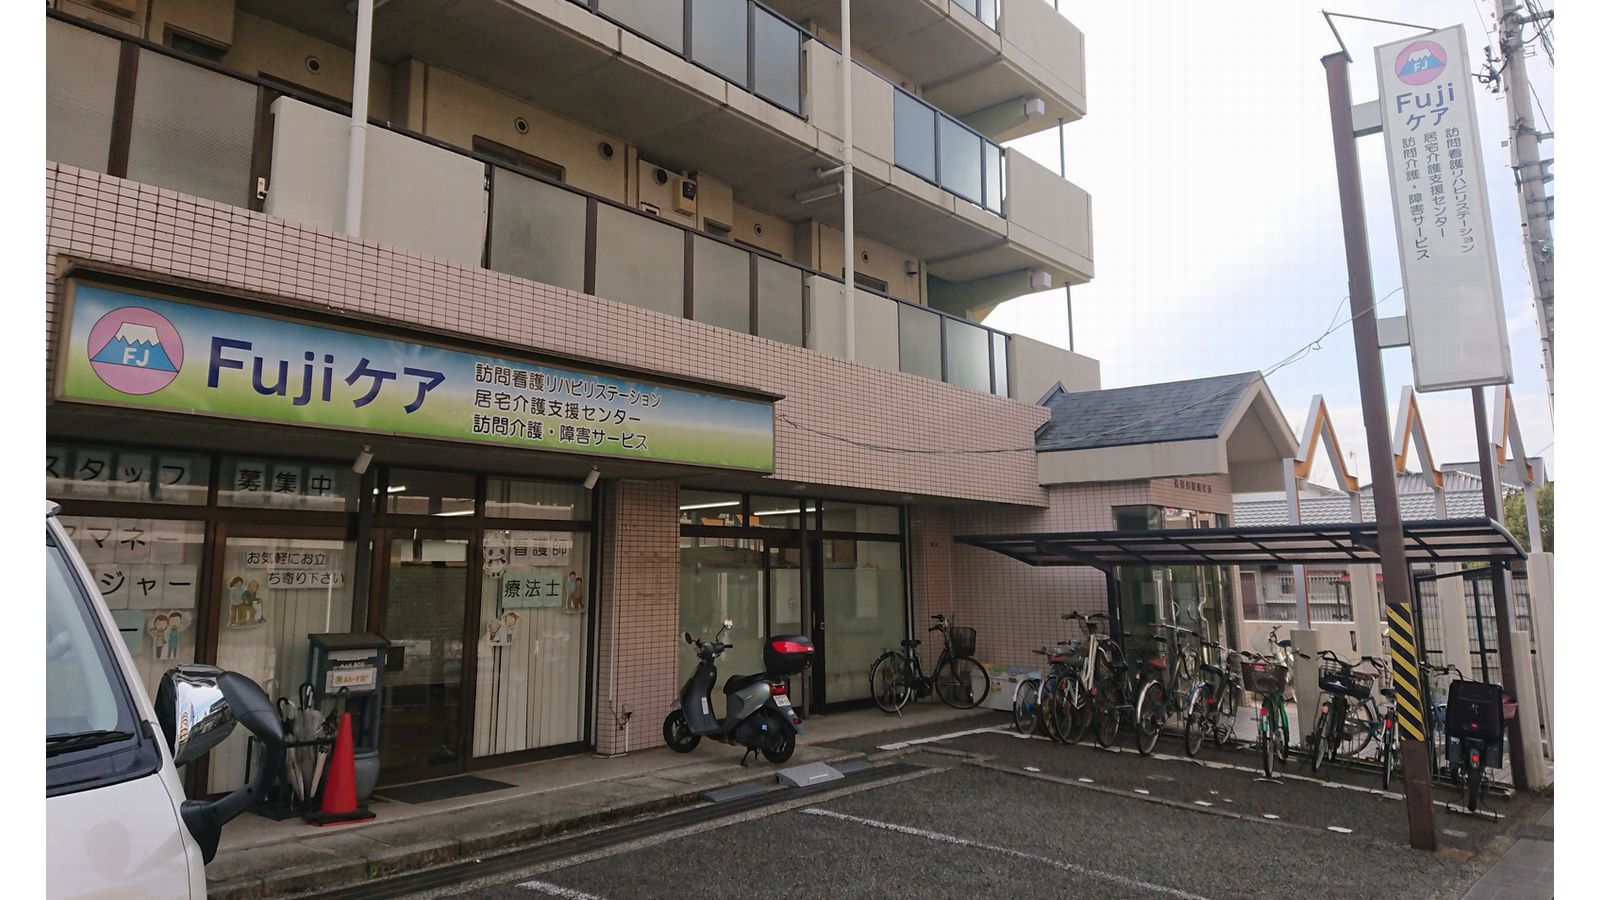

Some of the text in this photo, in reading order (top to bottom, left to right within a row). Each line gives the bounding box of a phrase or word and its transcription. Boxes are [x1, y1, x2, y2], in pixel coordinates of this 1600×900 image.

[1413, 60, 1429, 73] FJ
[1396, 82, 1455, 114] Fuji
[1406, 107, 1450, 132] ケア
[1402, 136, 1431, 261] 訪問介護・障害サービス
[1423, 131, 1448, 238] 居宅介護支援センター
[1445, 126, 1475, 254] 訪問看護リハビリステーション
[122, 346, 150, 367] FJ
[475, 363, 662, 408] 訪問看護リハビリステーション
[474, 390, 641, 425] 居宅介護支援センター
[472, 415, 649, 451] 訪問介護・障害サービス
[237, 468, 333, 495] 募集中
[247, 551, 326, 566] お気軽にお立
[268, 571, 345, 585] ち寄り下さい
[504, 578, 560, 598] 療法士
